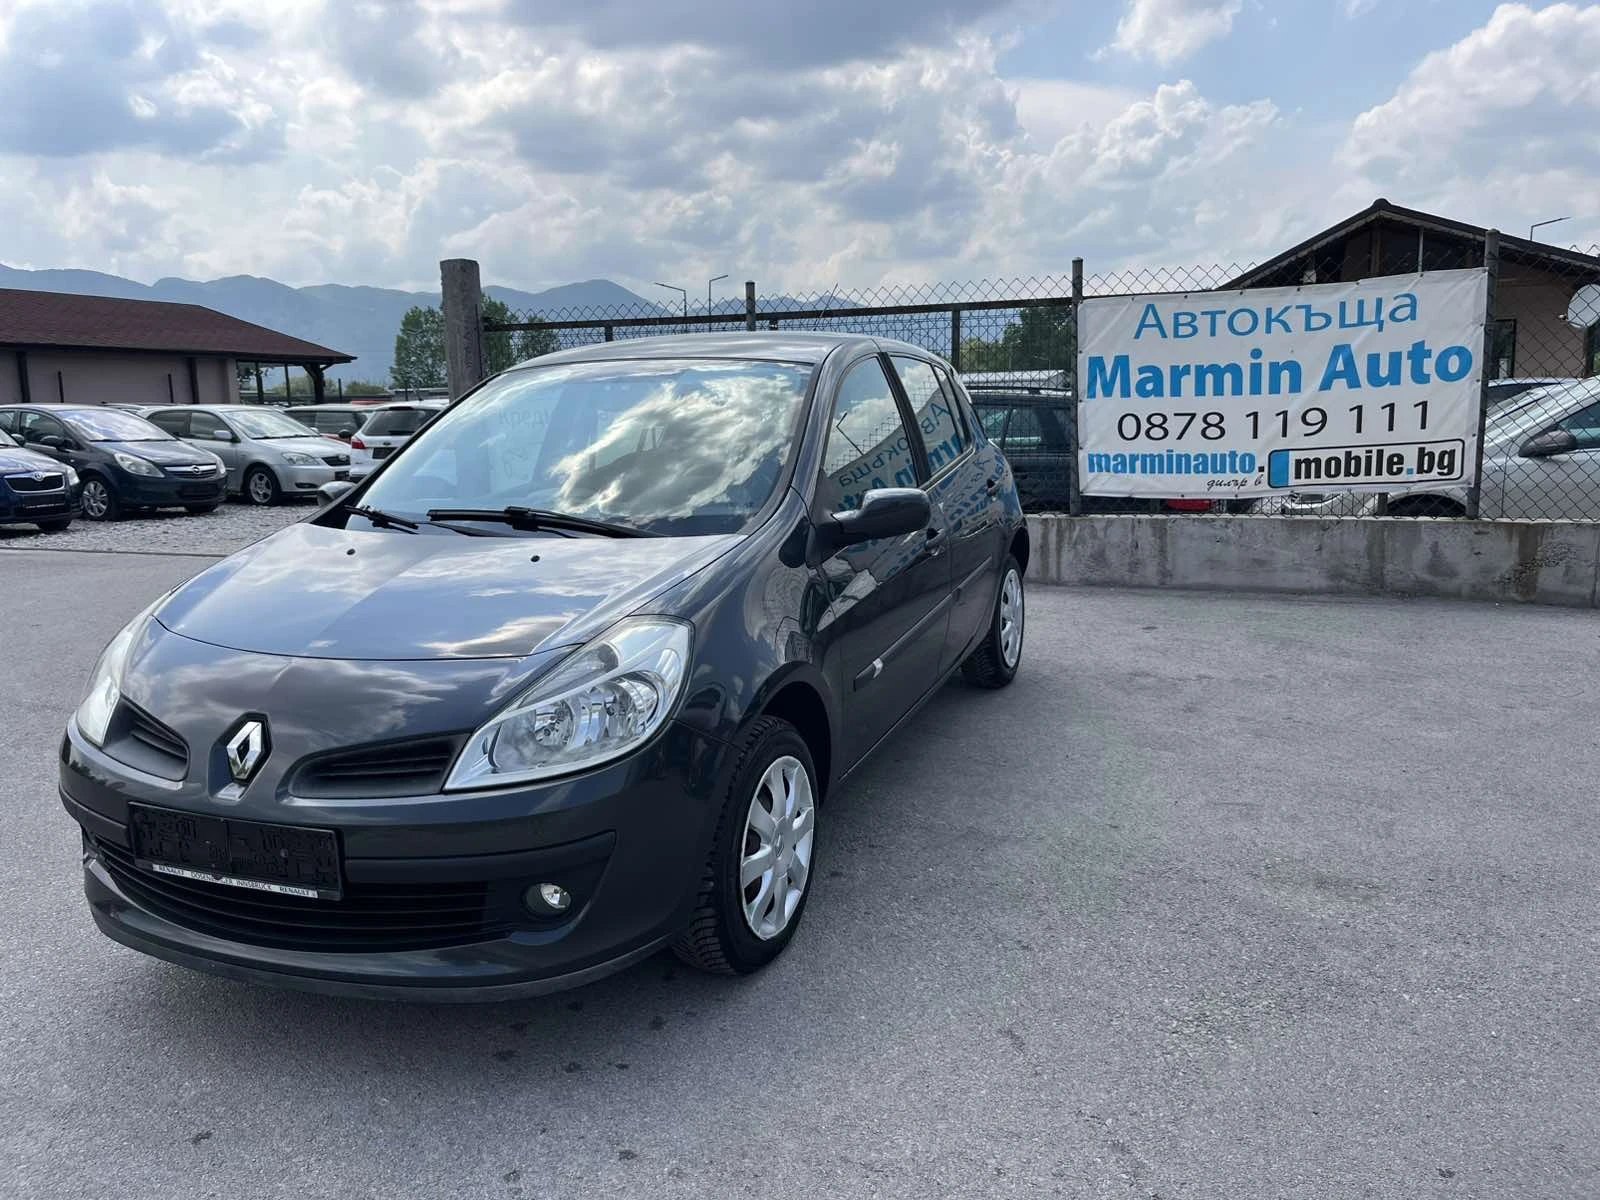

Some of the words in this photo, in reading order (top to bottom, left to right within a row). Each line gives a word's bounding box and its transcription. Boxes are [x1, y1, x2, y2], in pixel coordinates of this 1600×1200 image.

[1133, 292, 1418, 340] Автокъща
[1087, 348, 1302, 399] Marmin
[1319, 340, 1472, 392] Auto
[1117, 411, 1226, 441] 0878
[1245, 407, 1328, 439] 119
[1349, 401, 1429, 434] 111
[1294, 447, 1456, 478] mobile.bg
[279, 886, 310, 896] RENAULT
